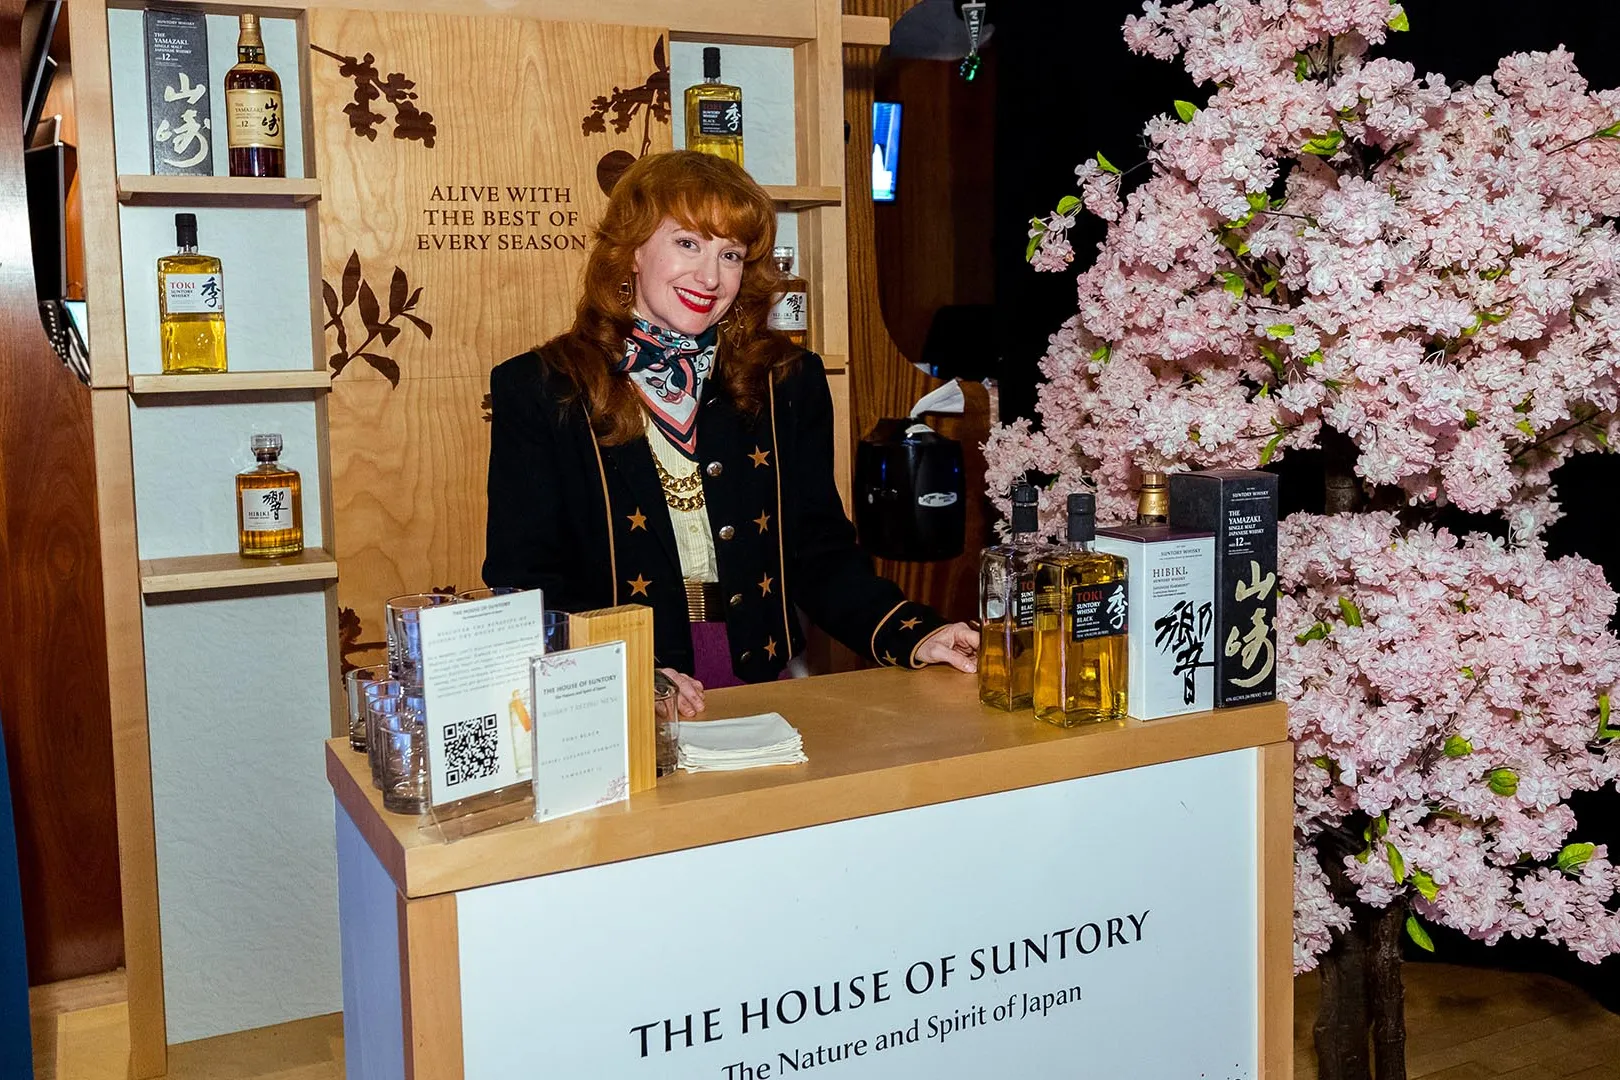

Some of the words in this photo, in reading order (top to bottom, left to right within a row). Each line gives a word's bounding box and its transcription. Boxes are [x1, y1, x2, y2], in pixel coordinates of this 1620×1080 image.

[162, 53, 171, 61] 12
[429, 185, 500, 202] ALIVE
[505, 186, 571, 203] WITH
[422, 209, 475, 226] THE
[482, 210, 541, 226] BEST
[548, 210, 579, 227] OF
[416, 234, 491, 251] EVERY
[497, 234, 587, 251] SEASON
[170, 281, 195, 289] TOKI
[1228, 515, 1262, 525] YAMAZAKI
[1235, 536, 1244, 547] 12
[1153, 566, 1186, 578] HIBIKI
[1021, 580, 1034, 592] TO
[1075, 590, 1103, 603] TOKI
[1076, 602, 1101, 610] SUNTORY
[1076, 608, 1097, 616] WHISKY
[1076, 616, 1093, 624] BLACK
[543, 687, 555, 695] THE
[556, 683, 578, 692] HOUSE
[588, 674, 617, 686] SUNTORY
[629, 997, 723, 1058] THE
[740, 970, 891, 1035] HOUSE
[905, 954, 956, 995] OF
[969, 909, 1150, 982] SUNTORY
[721, 1061, 771, 1080] The
[777, 1038, 868, 1075] Nature
[875, 1018, 920, 1051] and
[927, 1009, 987, 1043] Spirit
[992, 993, 1018, 1022] of
[1020, 984, 1082, 1020] Japan
